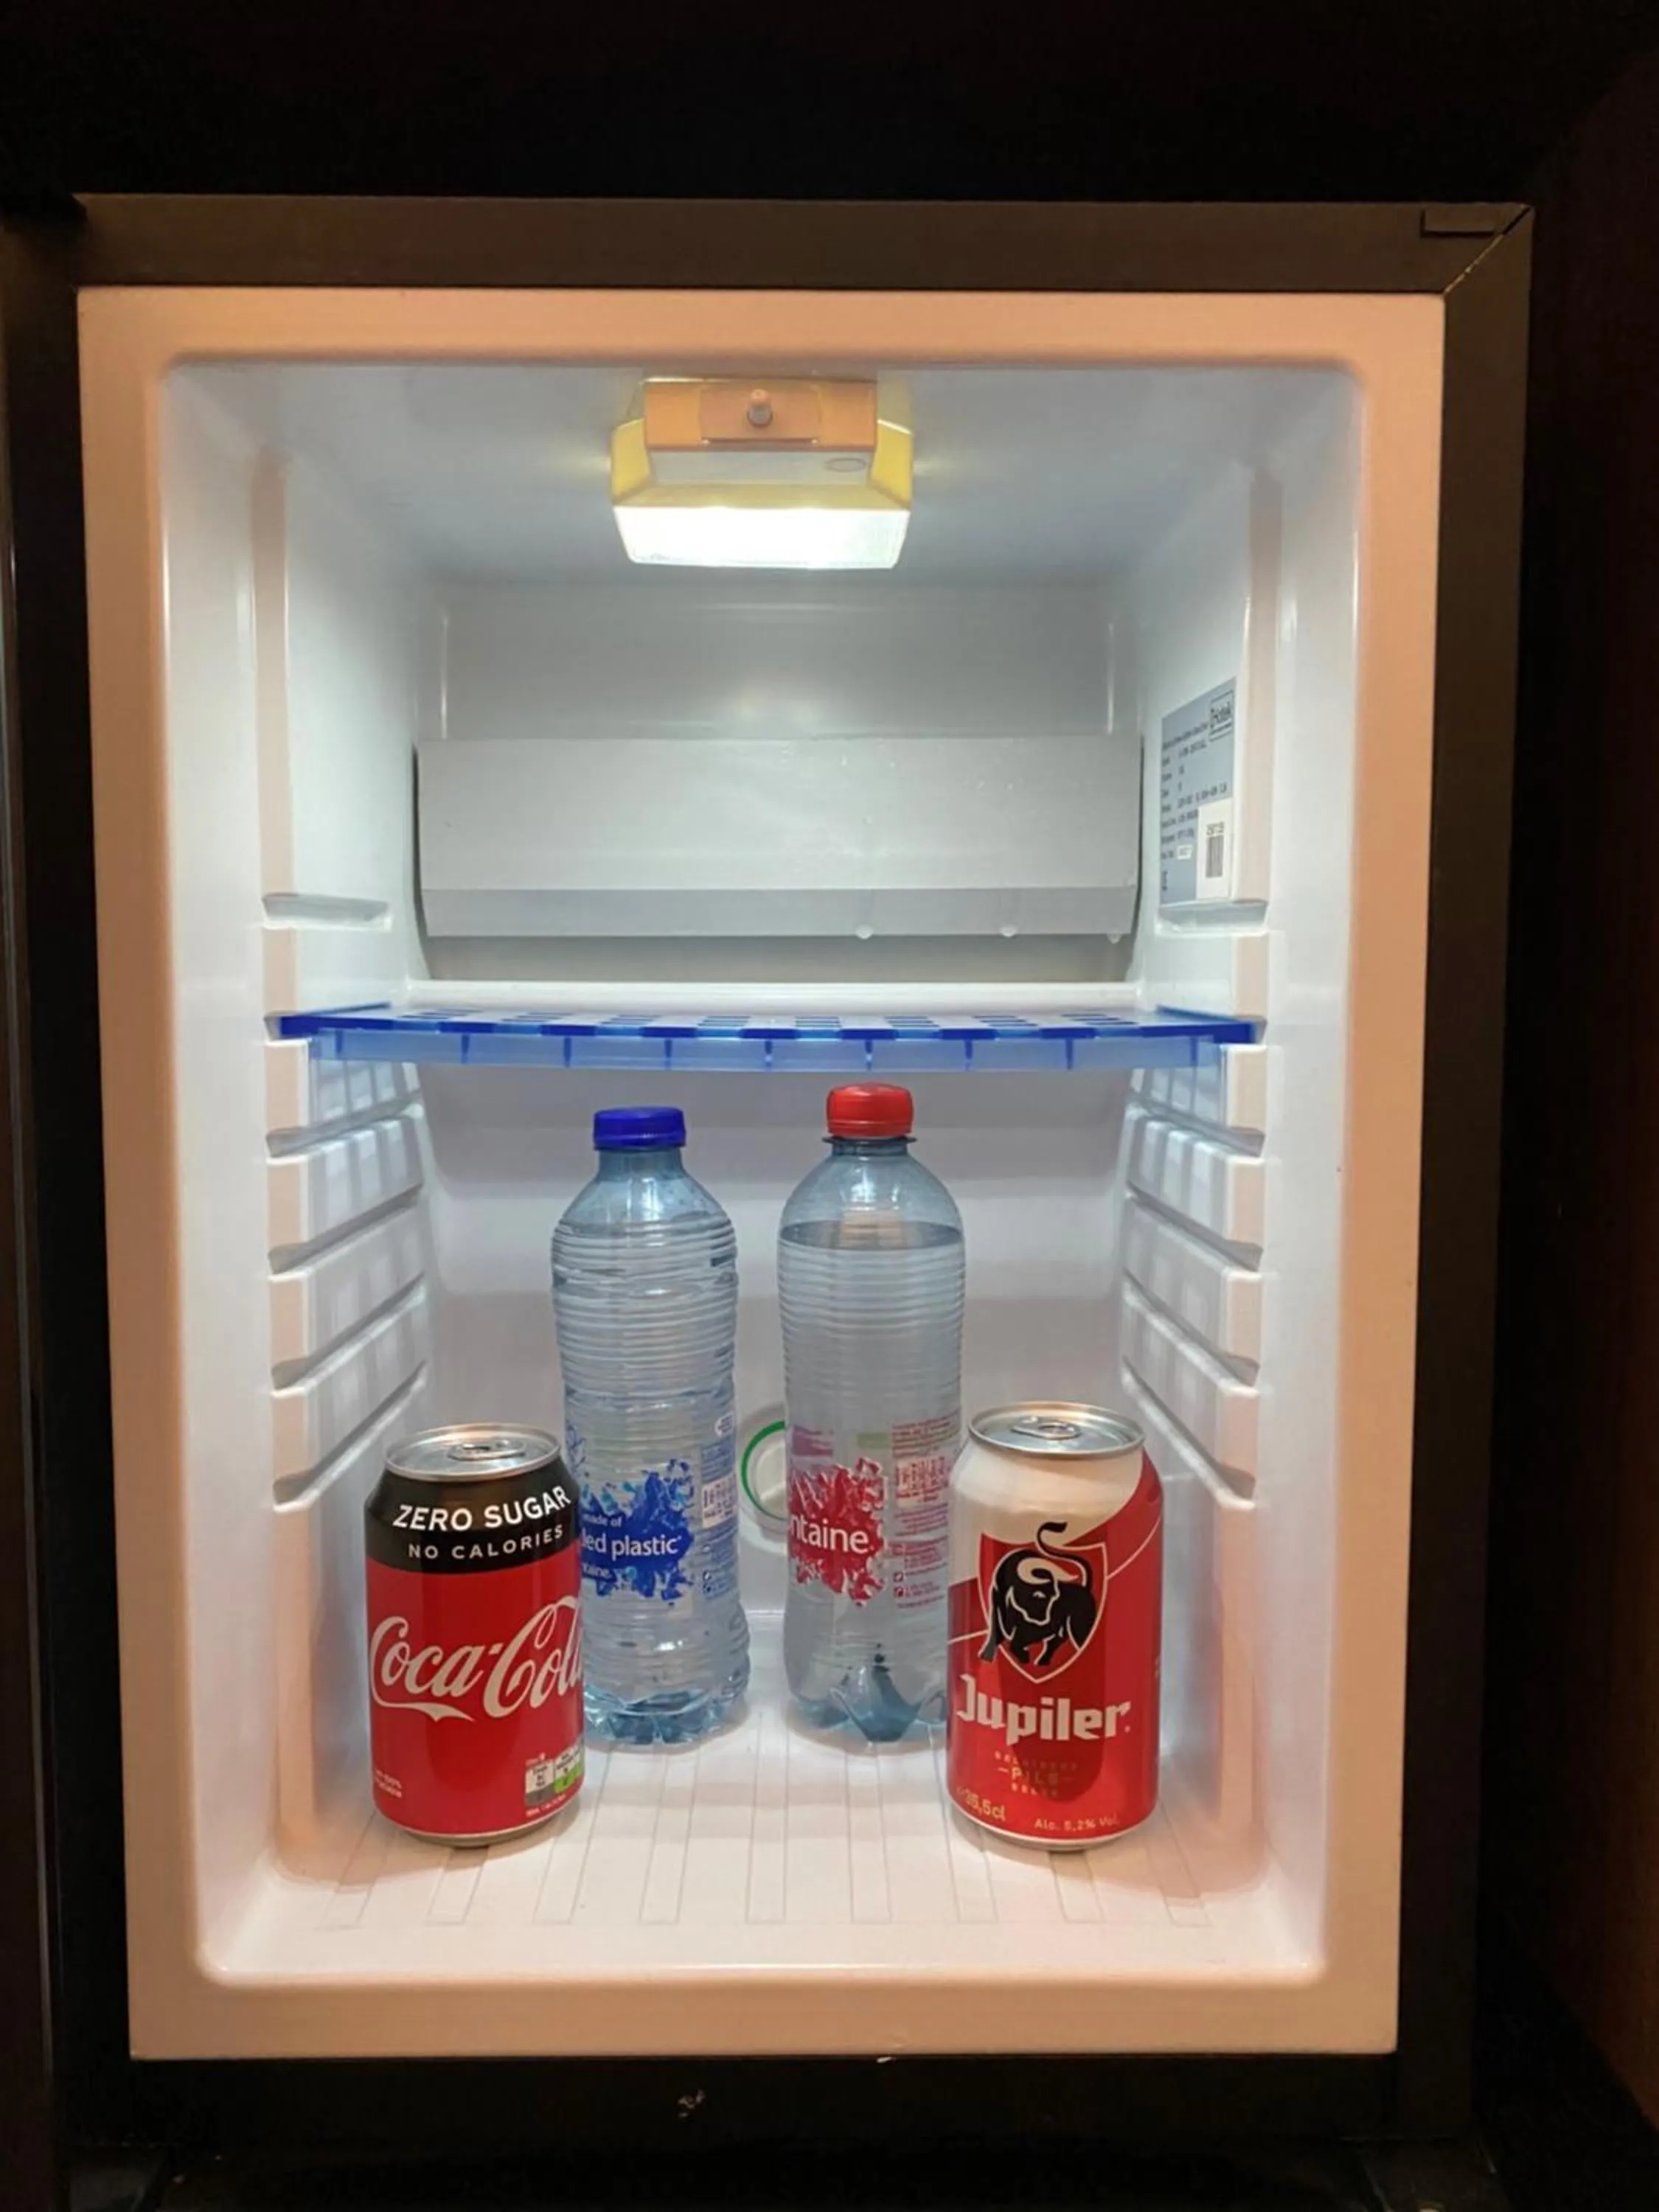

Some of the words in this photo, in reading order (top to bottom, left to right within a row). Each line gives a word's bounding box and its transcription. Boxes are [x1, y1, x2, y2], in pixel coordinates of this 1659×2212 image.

[392, 1504, 473, 1531] ZERO
[484, 1485, 571, 1528] SUGAR
[610, 1516, 622, 1528] of
[408, 1543, 439, 1559] NO
[451, 1524, 563, 1559] CALORIES
[956, 1673, 1131, 1746] Jupiler
